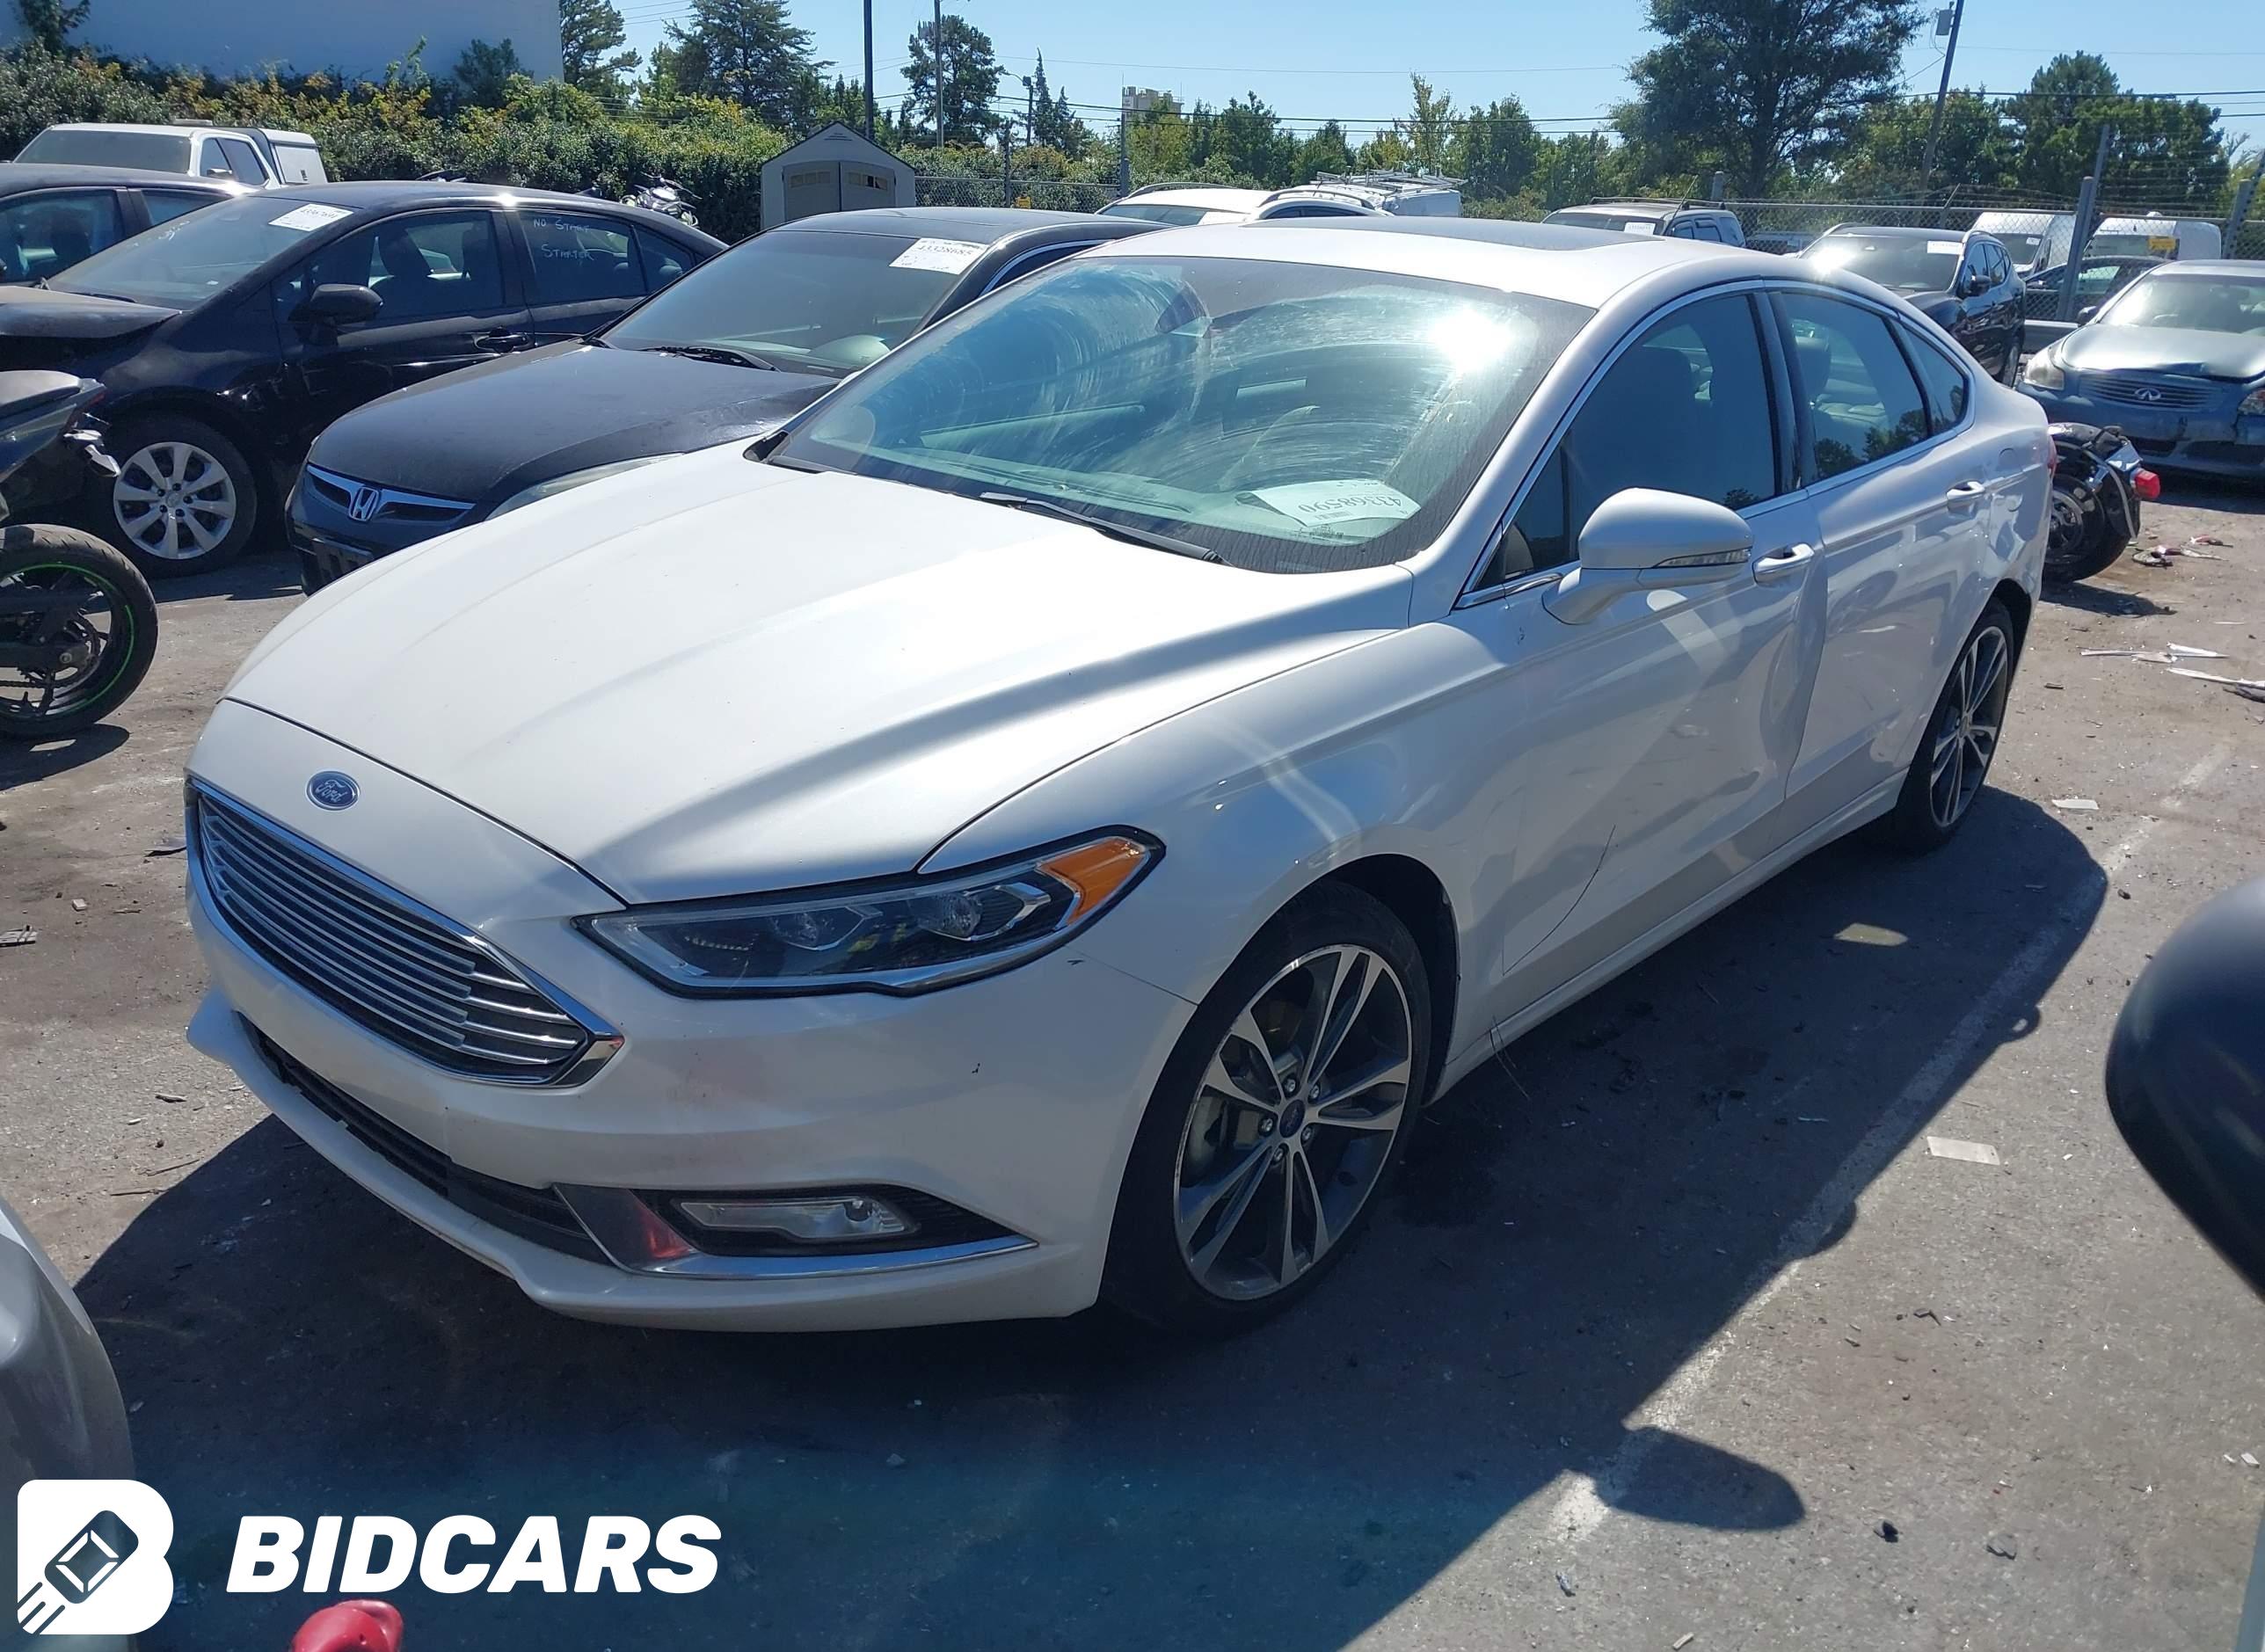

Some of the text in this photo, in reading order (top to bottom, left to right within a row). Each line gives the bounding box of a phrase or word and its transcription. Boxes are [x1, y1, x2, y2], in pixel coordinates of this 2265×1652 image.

[533, 218, 546, 228] NO
[1298, 495, 1402, 513] 43368590
[315, 779, 348, 803] Ford
